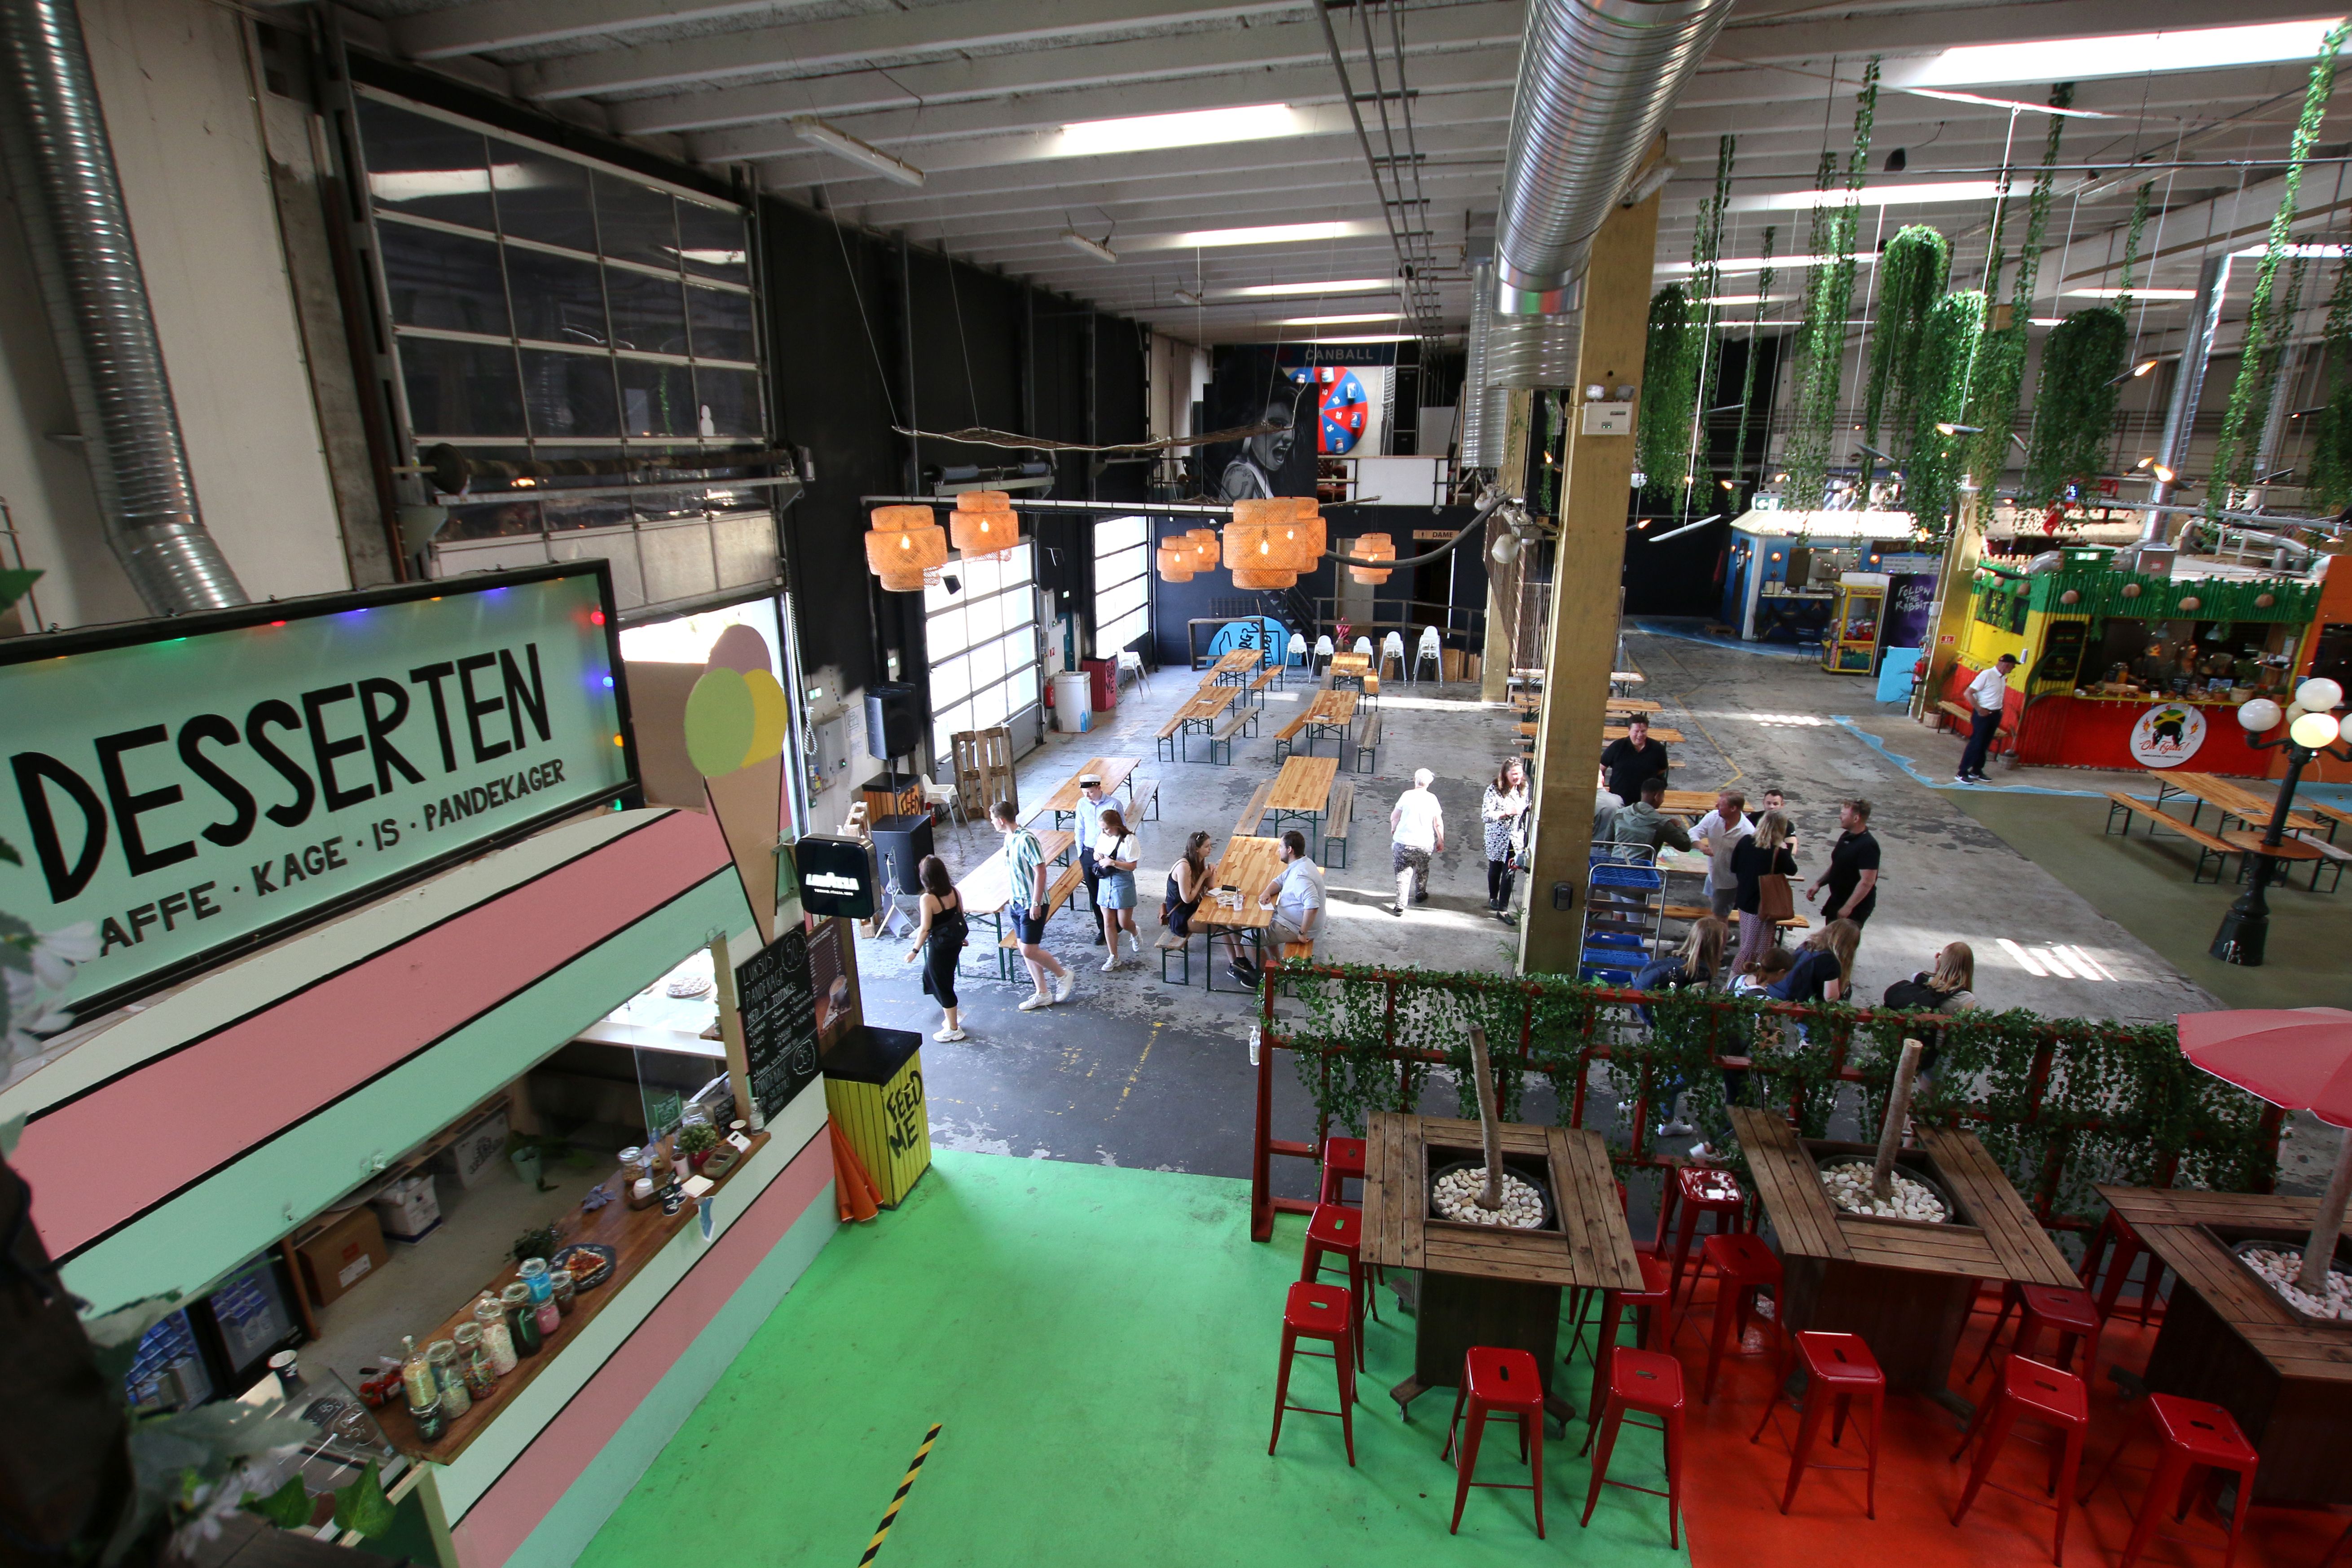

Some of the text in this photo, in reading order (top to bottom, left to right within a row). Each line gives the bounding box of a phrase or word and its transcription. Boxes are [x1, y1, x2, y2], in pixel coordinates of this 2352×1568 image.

[1305, 348, 1374, 360] CANBALL
[1895, 600, 1930, 613] RABBIT
[1898, 584, 1931, 597] FOLLOW
[1905, 594, 1920, 603] THE
[12, 642, 551, 904] DESSERTEN
[92, 759, 566, 960] AFFE KAGE IS PANDEKAGER
[742, 951, 774, 986] LUKSUS
[745, 966, 784, 1009] PANDEKAGE
[747, 1008, 759, 1026] MED
[763, 1001, 768, 1013] 2
[886, 1070, 923, 1124] FEED
[889, 1110, 919, 1160] ME
